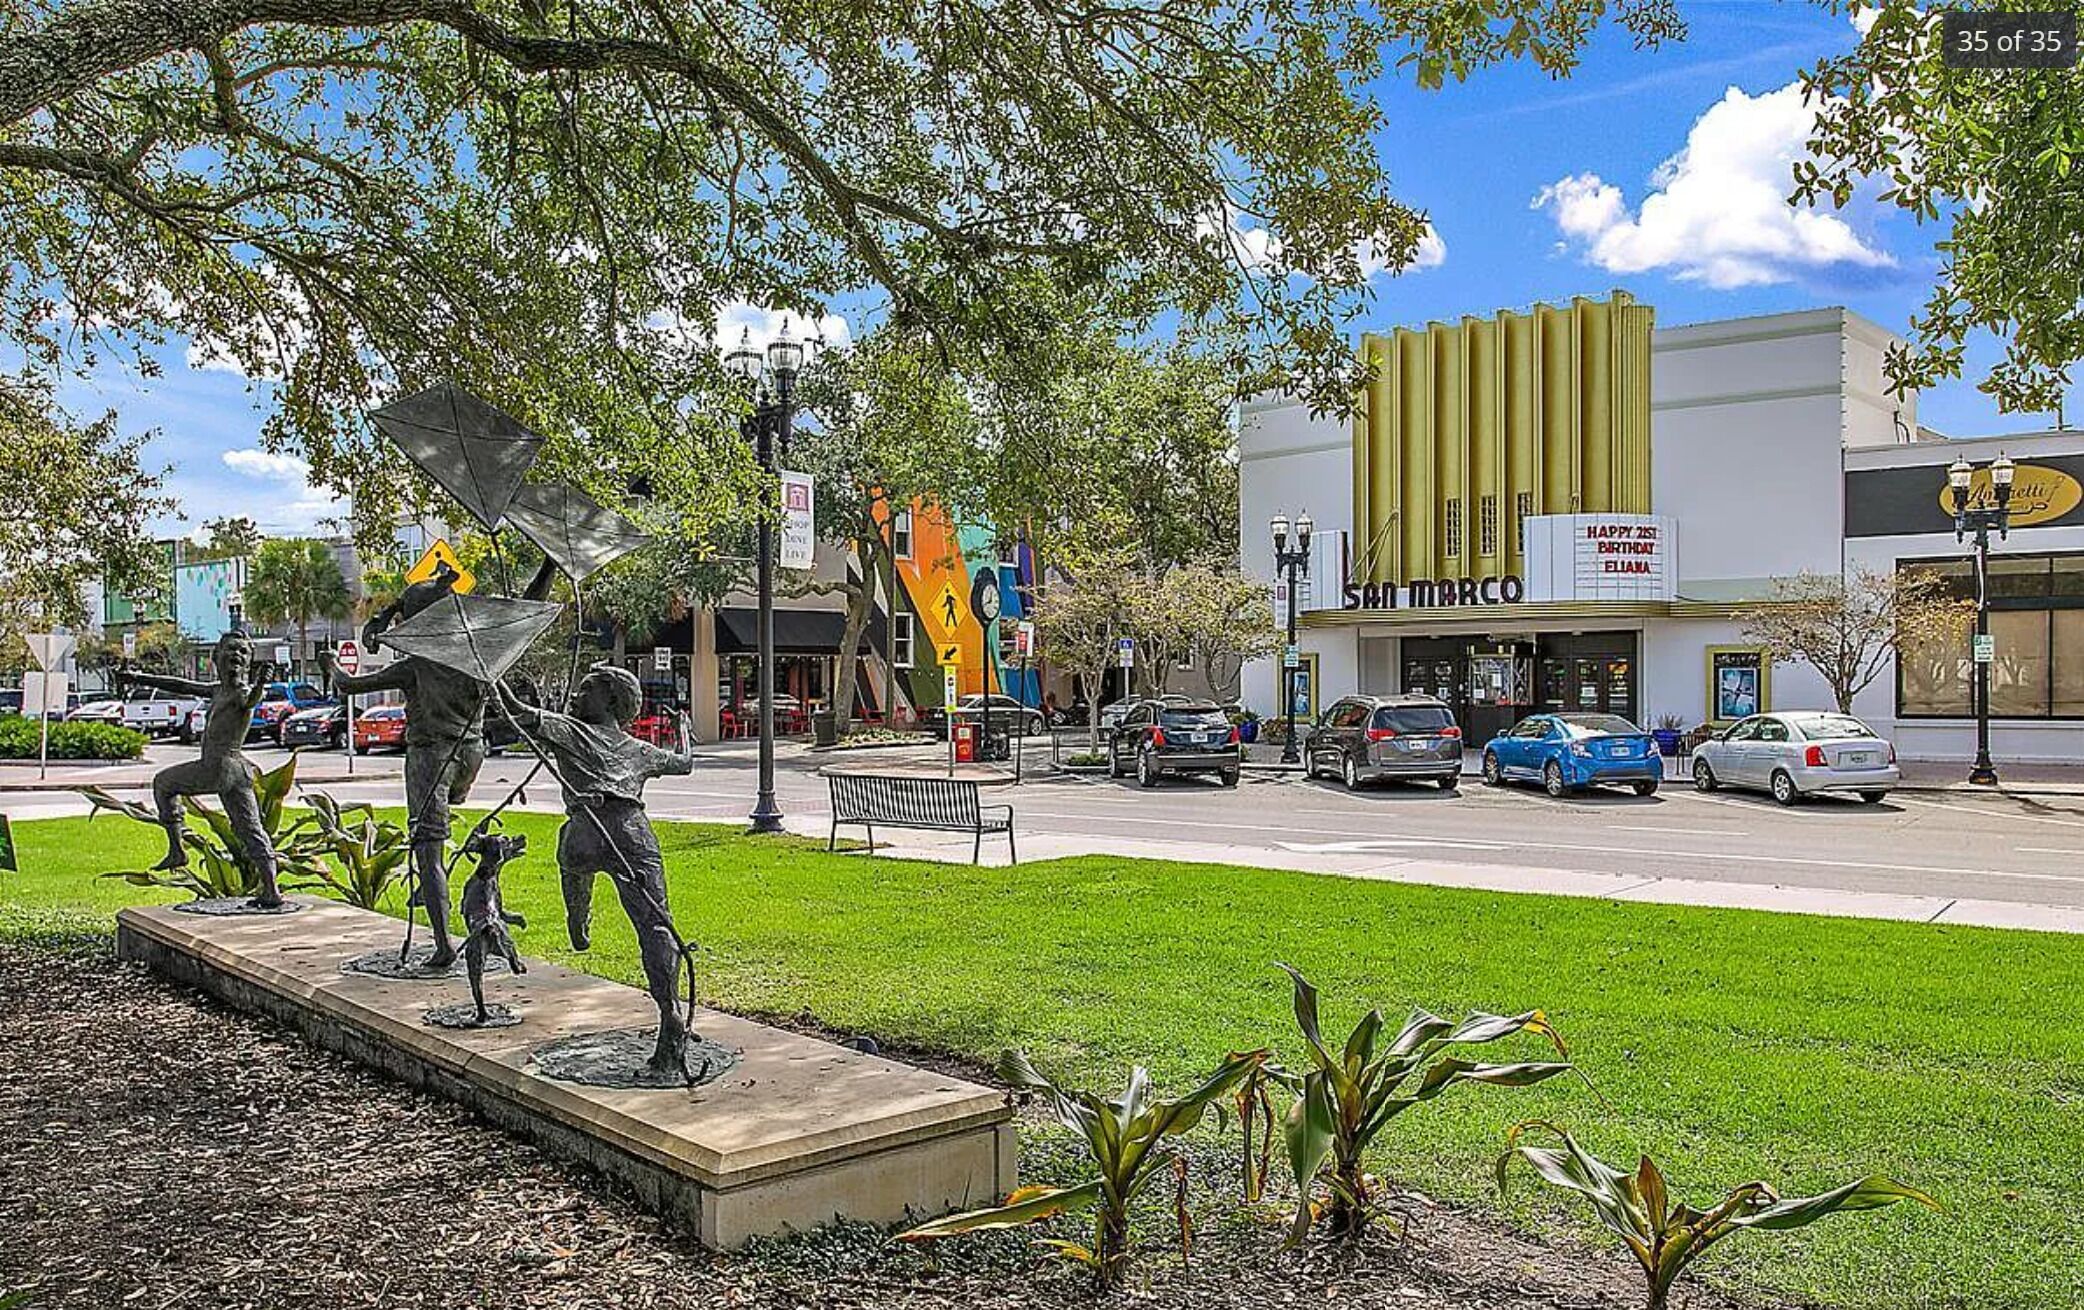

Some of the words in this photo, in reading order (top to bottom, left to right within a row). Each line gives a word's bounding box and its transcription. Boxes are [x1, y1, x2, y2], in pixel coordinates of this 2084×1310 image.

[1587, 526, 1634, 539] HAPPY
[1636, 526, 1657, 539] 21ST
[1598, 541, 1655, 555] BIRTHDAY
[1605, 560, 1652, 574] ELIANA
[1343, 581, 1398, 610] SAN
[1408, 575, 1523, 608] MARCO
